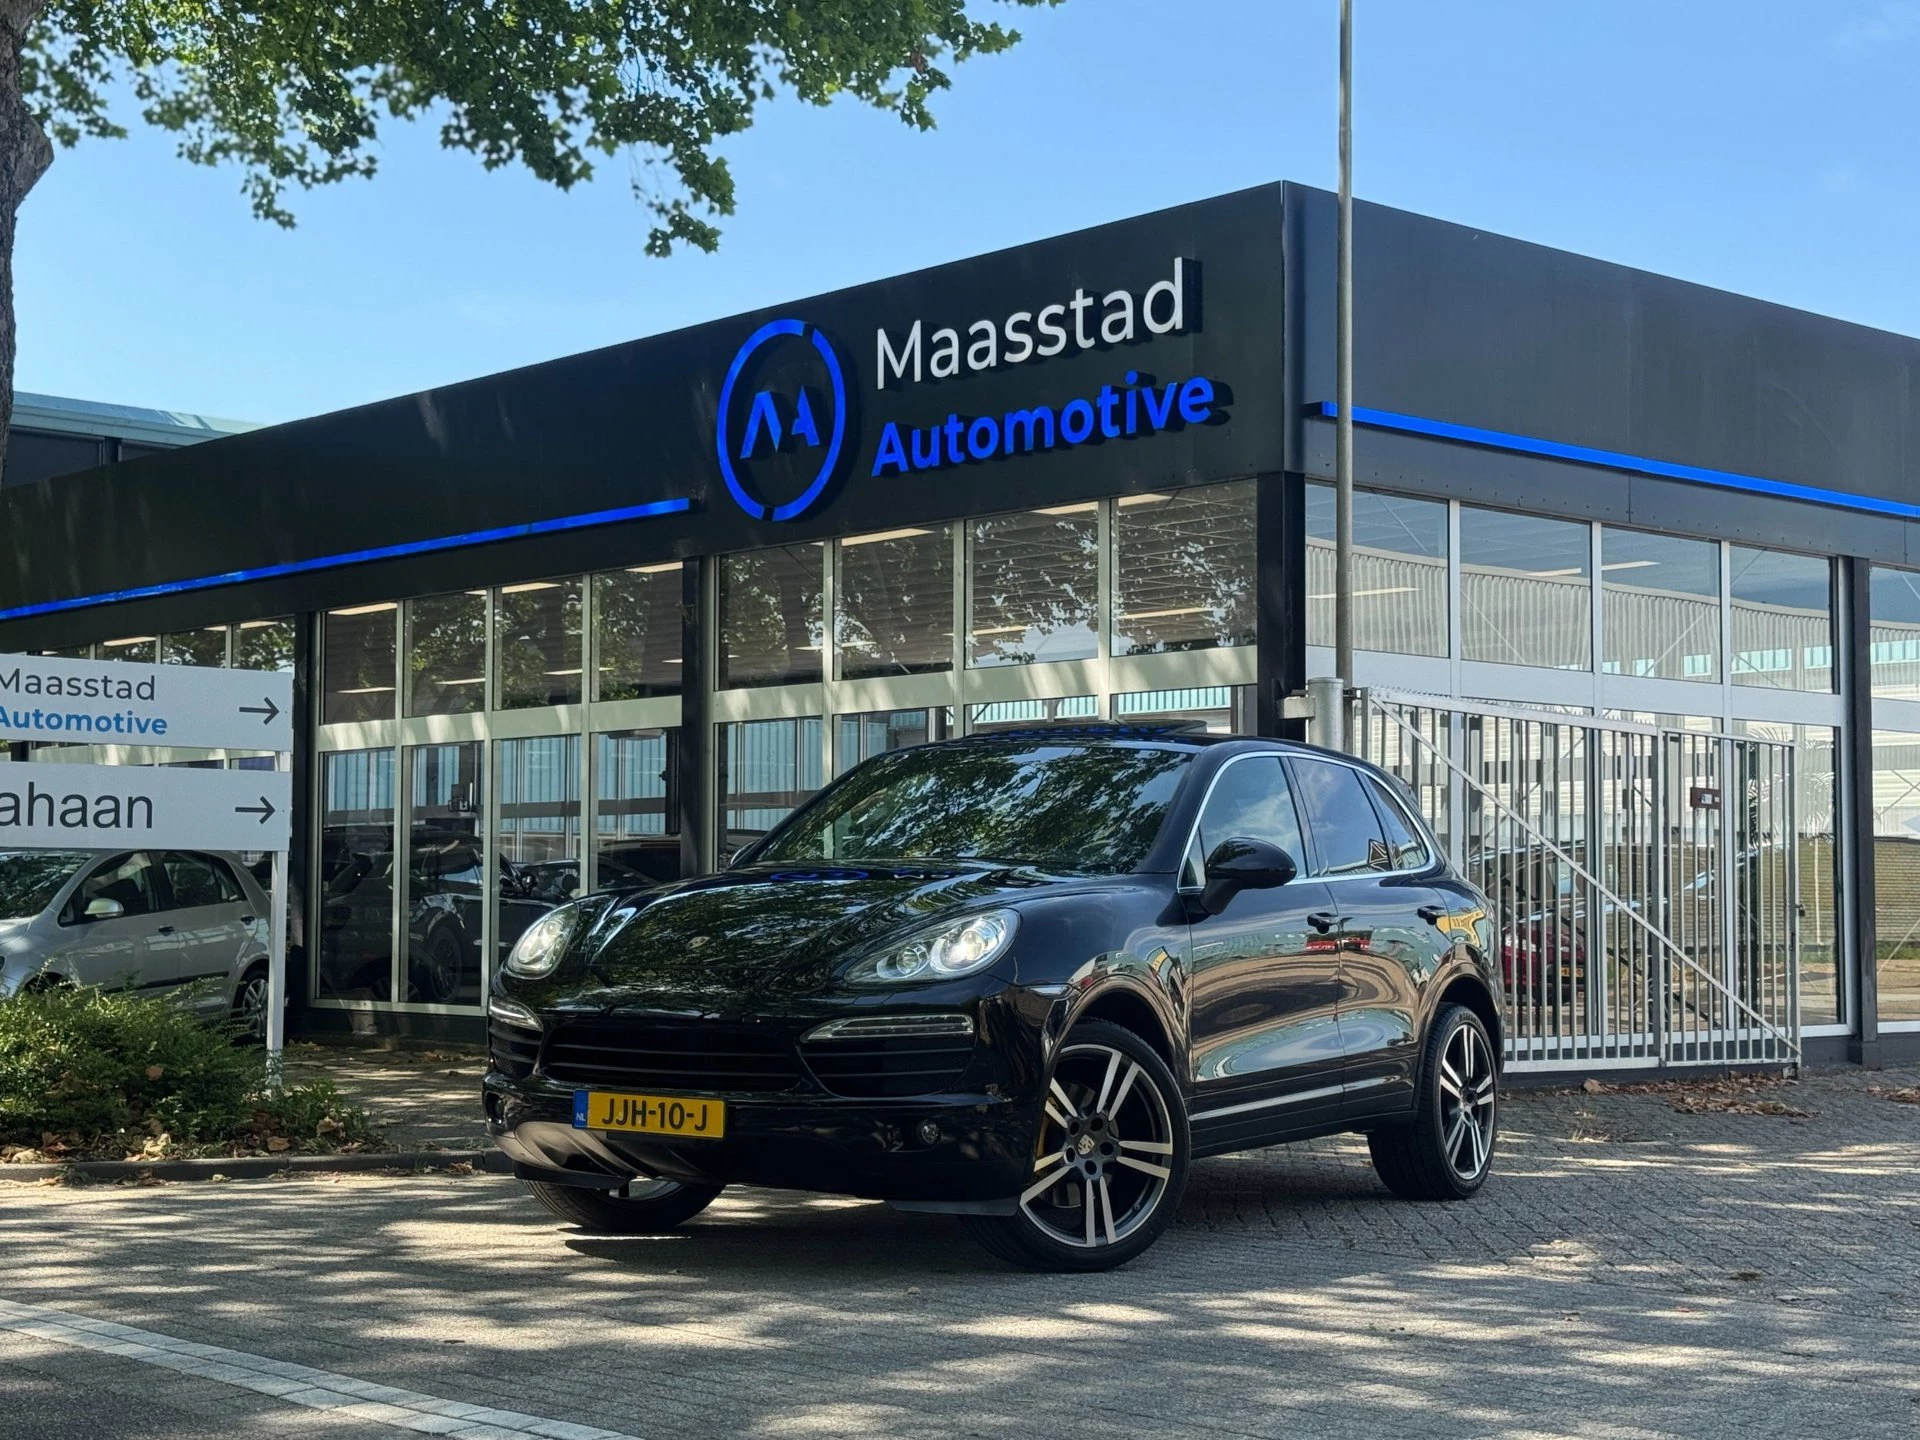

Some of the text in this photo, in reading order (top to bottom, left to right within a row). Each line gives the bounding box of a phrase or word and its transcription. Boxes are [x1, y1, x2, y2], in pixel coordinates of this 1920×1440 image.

[877, 256, 1184, 390] Maasstad
[871, 370, 1215, 477] Automotive
[0, 668, 156, 701] Maasstad
[0, 705, 168, 735] Automotive
[575, 1098, 708, 1131] NL JJH-10-J
